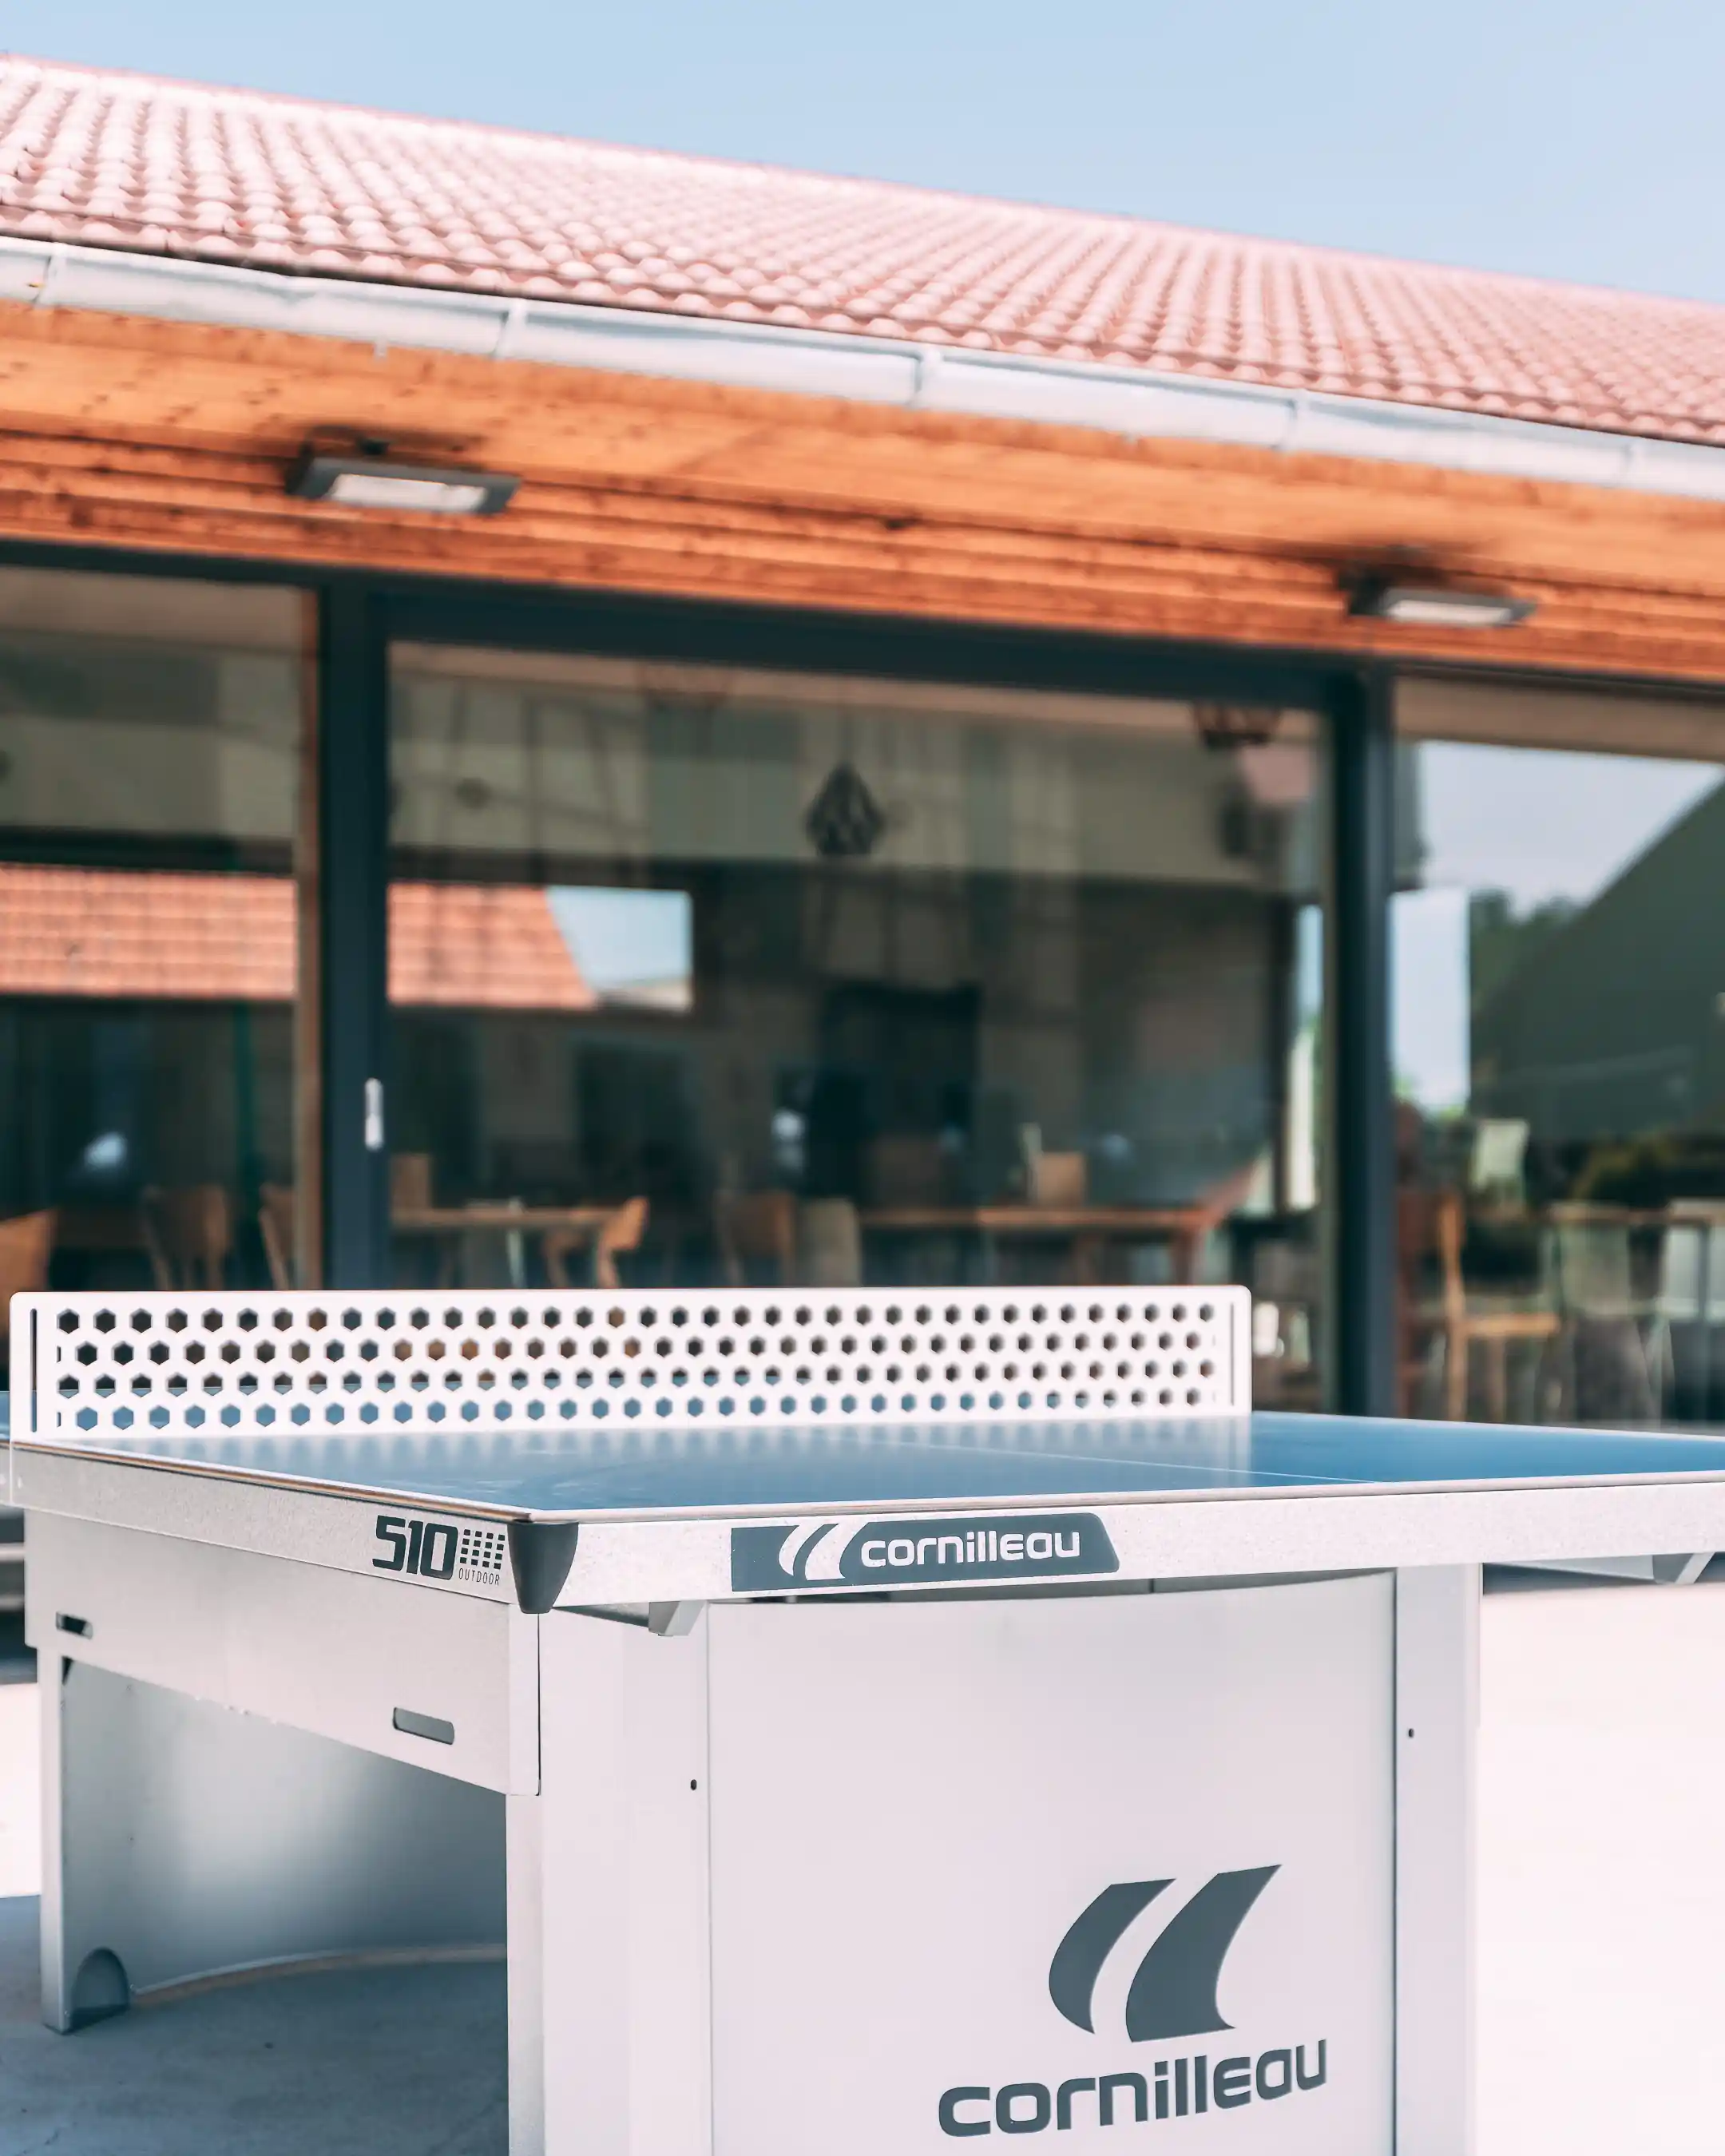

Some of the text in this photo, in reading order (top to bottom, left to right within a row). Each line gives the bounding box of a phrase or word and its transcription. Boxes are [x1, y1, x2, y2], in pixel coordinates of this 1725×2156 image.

[372, 1515, 458, 1580] 510
[861, 1530, 1081, 1568] cornilleau
[458, 1567, 501, 1585] OUTDOOR
[938, 2039, 1326, 2137] cornilleau
